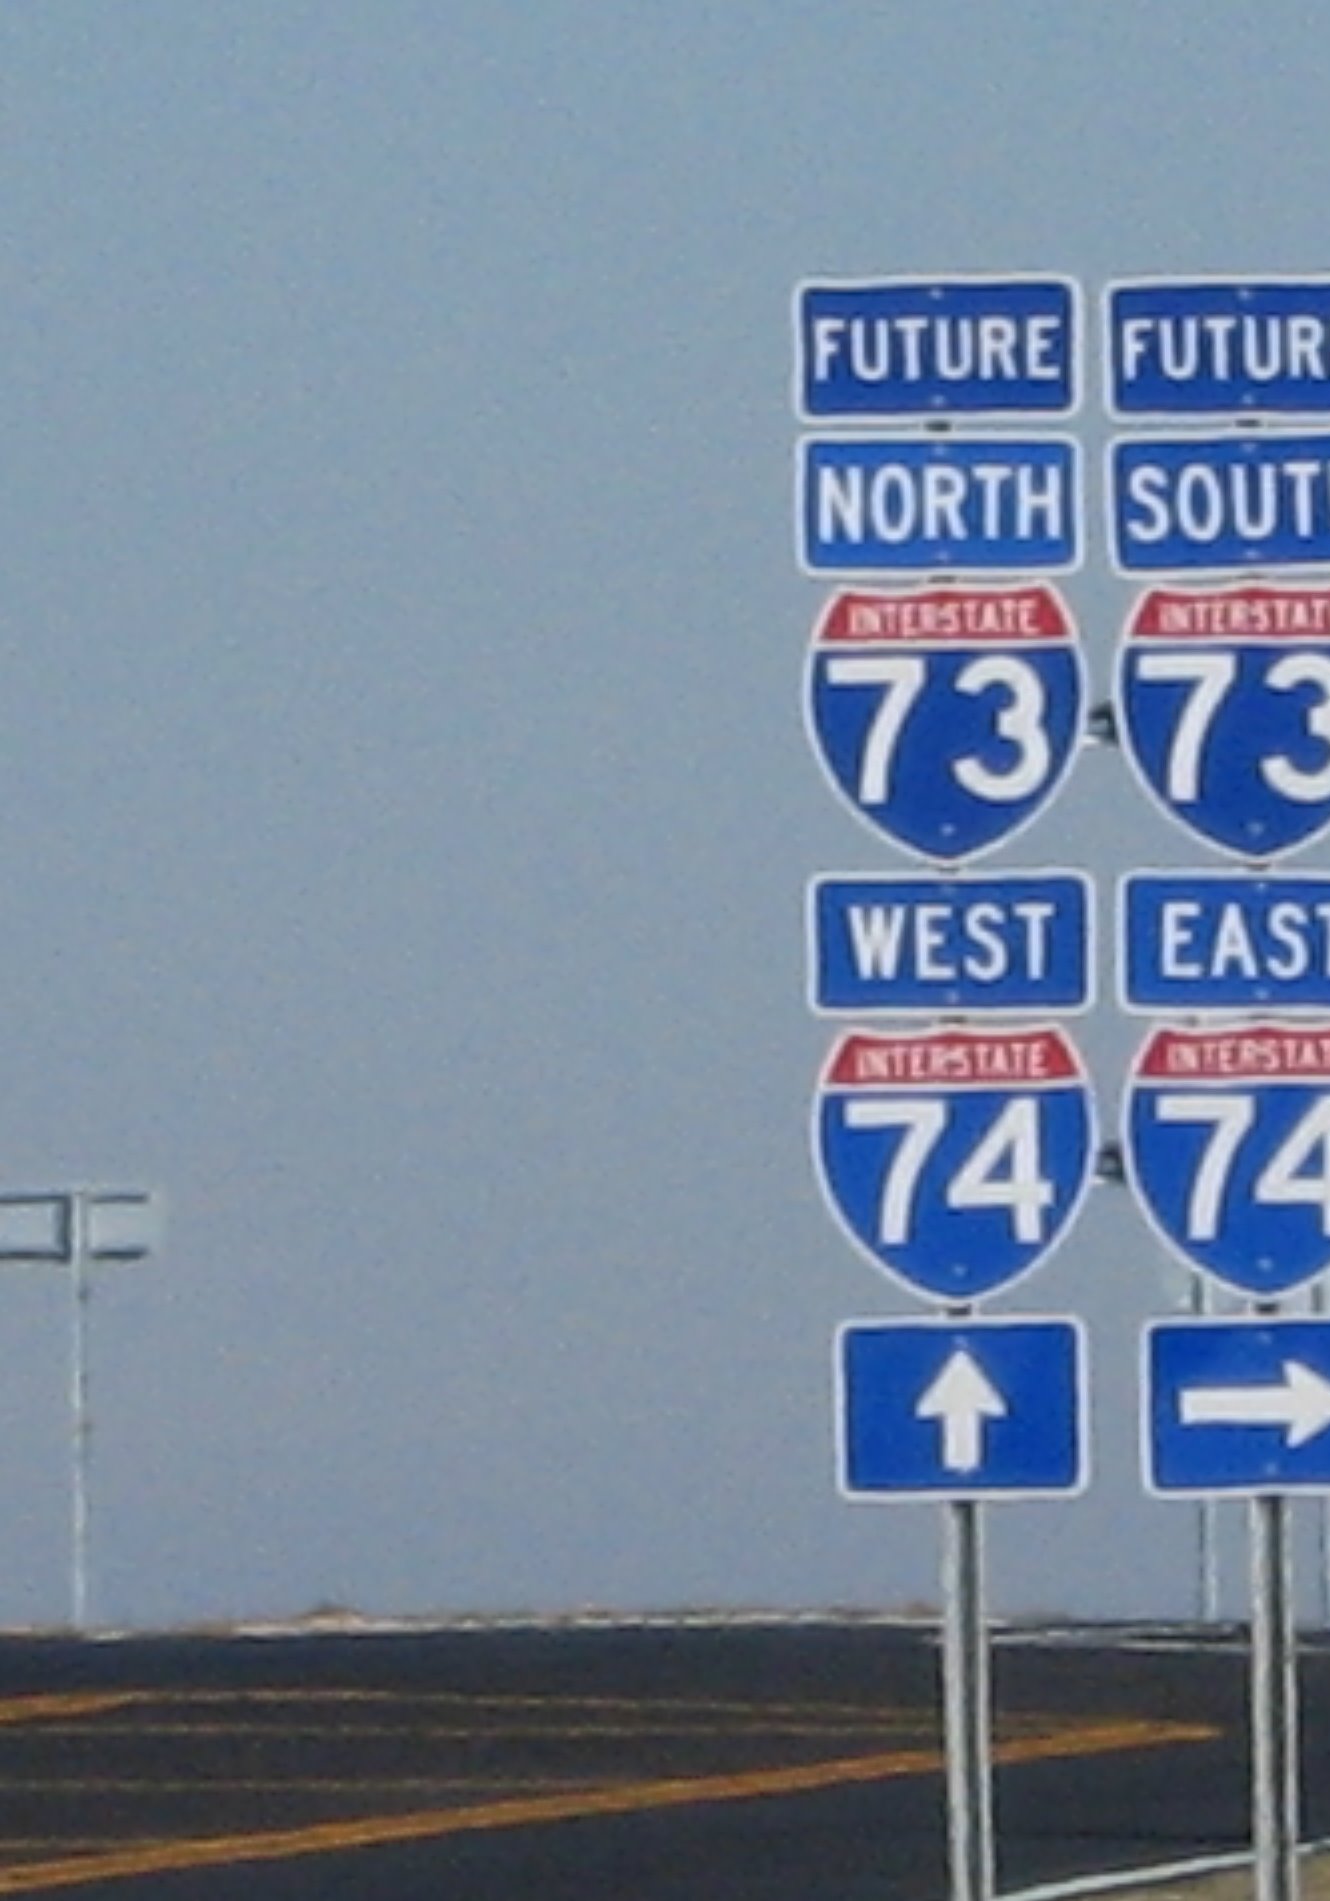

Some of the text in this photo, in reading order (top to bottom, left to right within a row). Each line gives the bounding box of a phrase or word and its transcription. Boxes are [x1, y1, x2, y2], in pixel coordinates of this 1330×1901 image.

[813, 316, 1061, 380] FUTURE
[817, 464, 1062, 544] NORTH
[848, 599, 1041, 637] INTERSTATE
[826, 655, 1051, 805] 73
[847, 904, 1055, 980] WEST
[855, 1042, 1051, 1078] INTERSTATE
[845, 1098, 1054, 1244] 74
